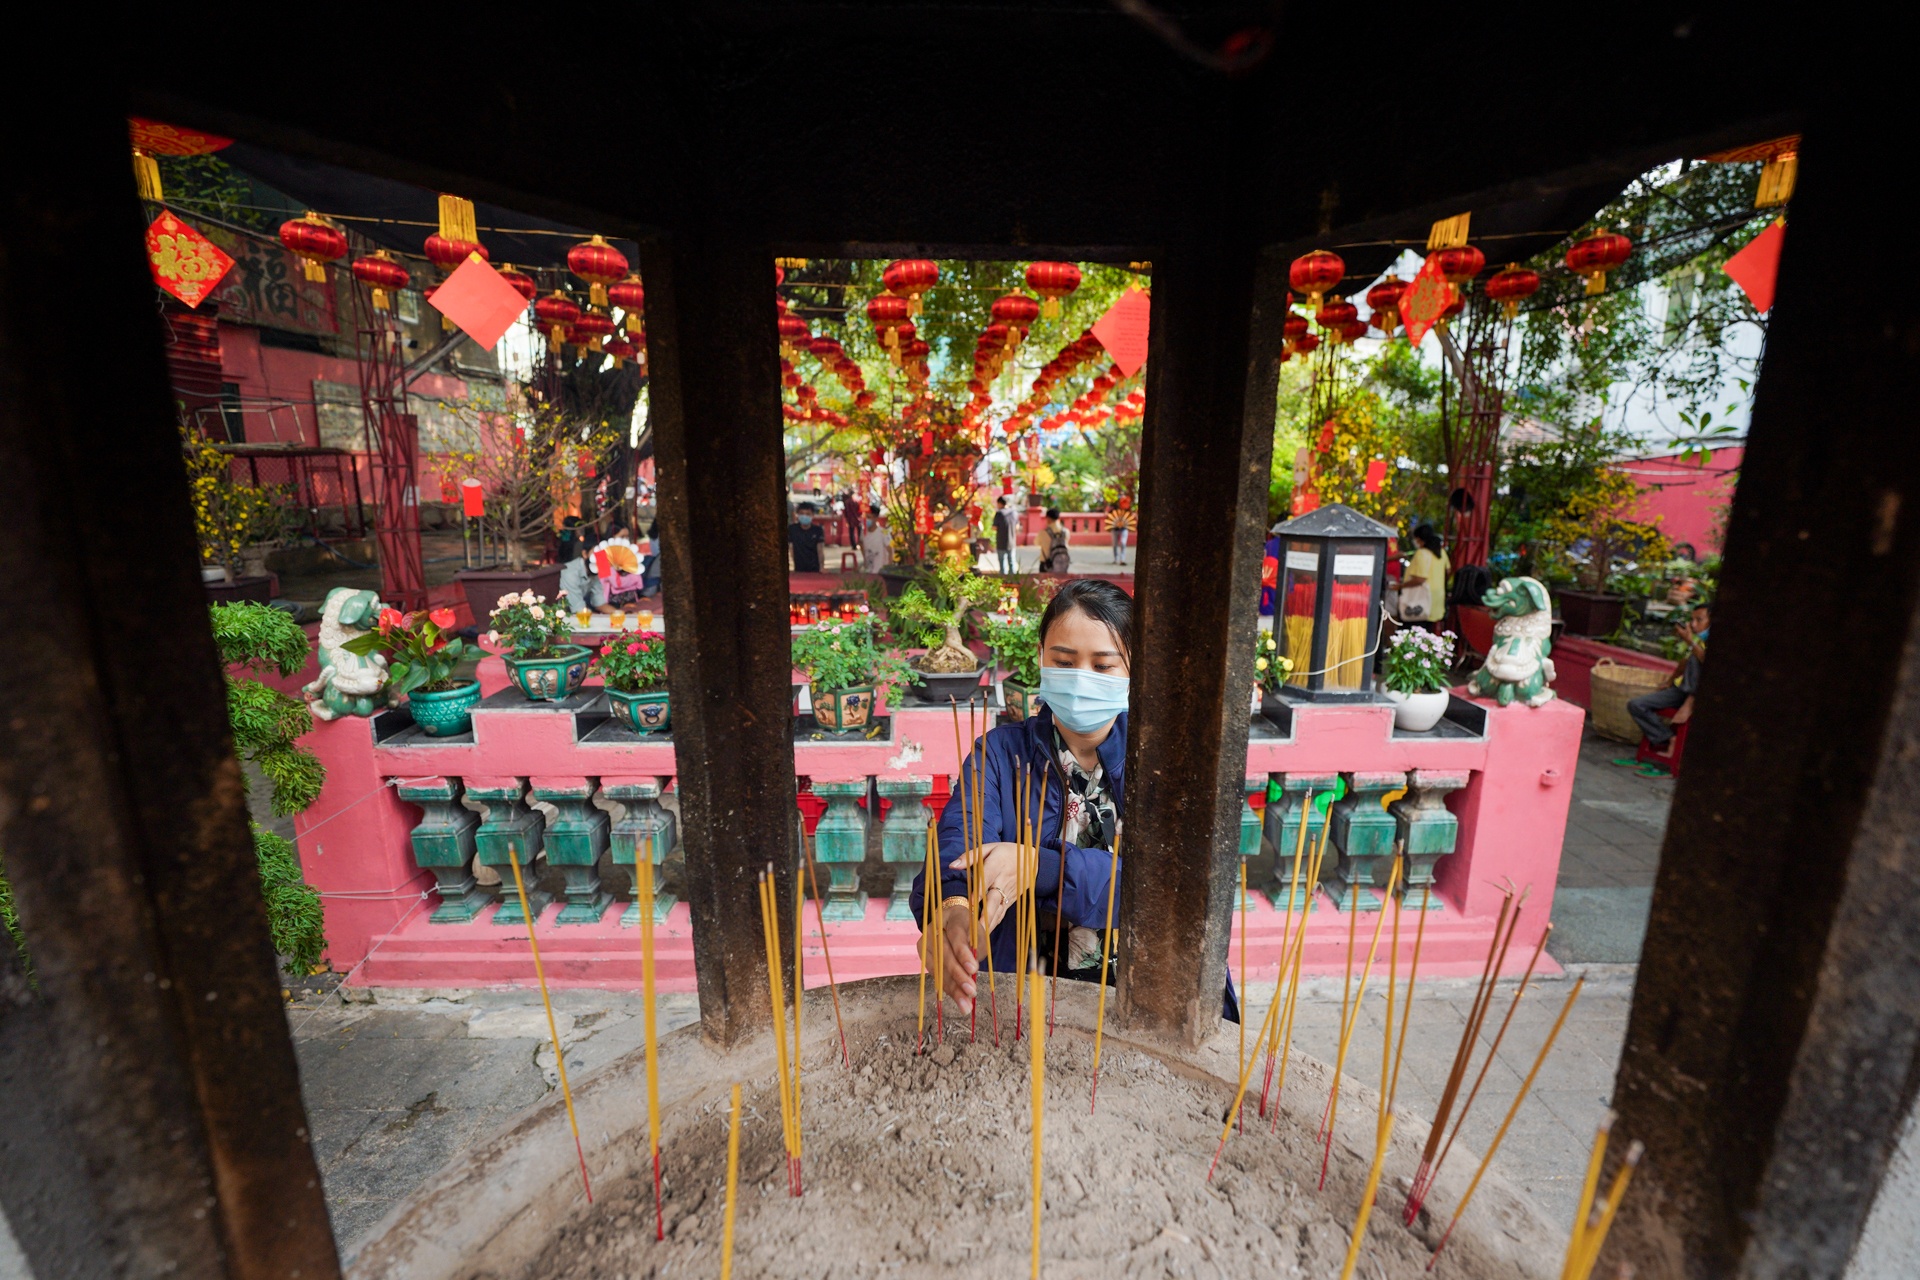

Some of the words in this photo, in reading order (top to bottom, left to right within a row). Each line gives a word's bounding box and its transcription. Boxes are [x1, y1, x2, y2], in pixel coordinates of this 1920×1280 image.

[151, 234, 209, 281] 福
[237, 240, 299, 320] 福
[1409, 276, 1437, 321] 福
